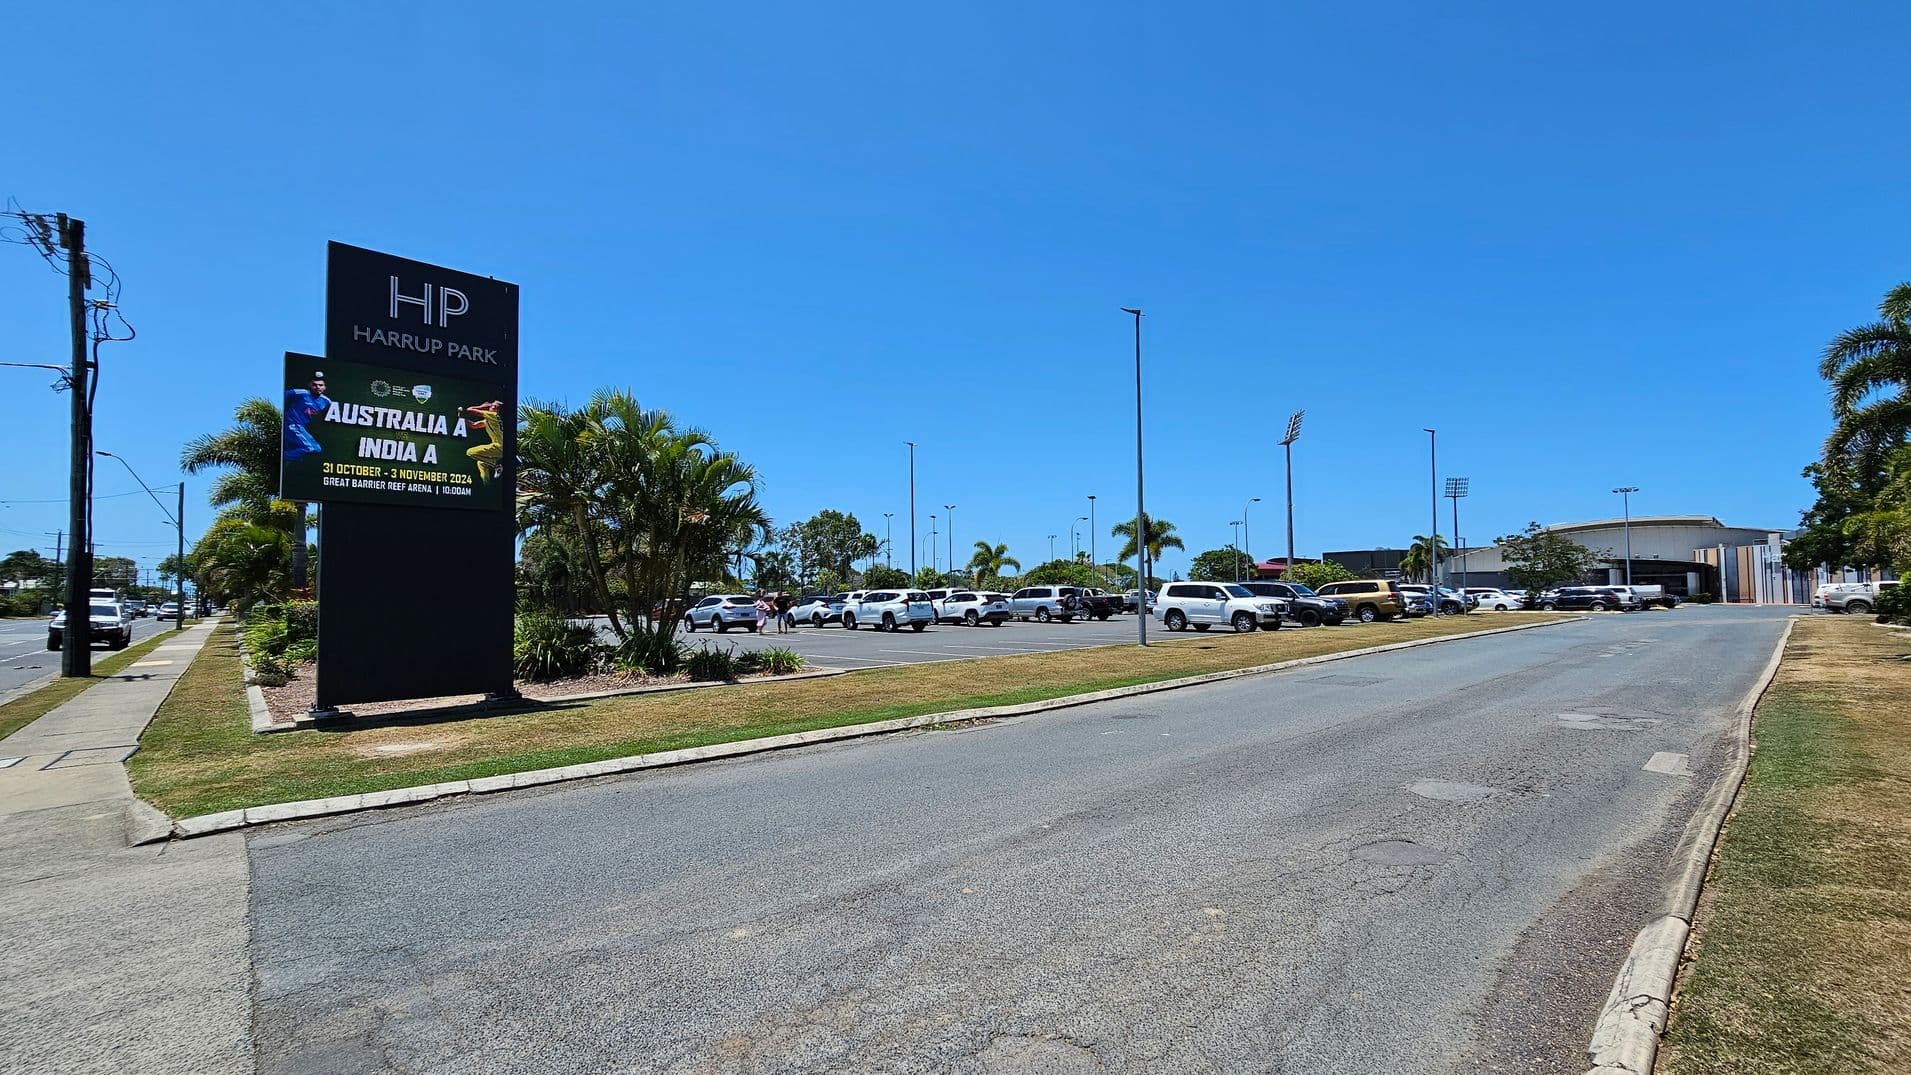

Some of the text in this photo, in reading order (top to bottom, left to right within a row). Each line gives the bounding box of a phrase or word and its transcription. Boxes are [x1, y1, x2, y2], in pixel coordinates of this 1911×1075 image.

[389, 275, 469, 328] HP
[353, 324, 498, 365] HARRUP PARK
[325, 401, 467, 438] AUSTRALIA A
[358, 436, 438, 464] INDIA A
[323, 463, 334, 474] 31
[336, 464, 381, 477] OCTOBER
[391, 469, 397, 479] 3
[399, 470, 447, 483] NOVEMBER
[450, 474, 472, 485] 2024
[323, 477, 350, 488] GREAT
[352, 479, 386, 490] BARRIER
[387, 481, 406, 491] REEF
[408, 483, 432, 493] ARENA
[442, 486, 471, 496] 10:00AM
